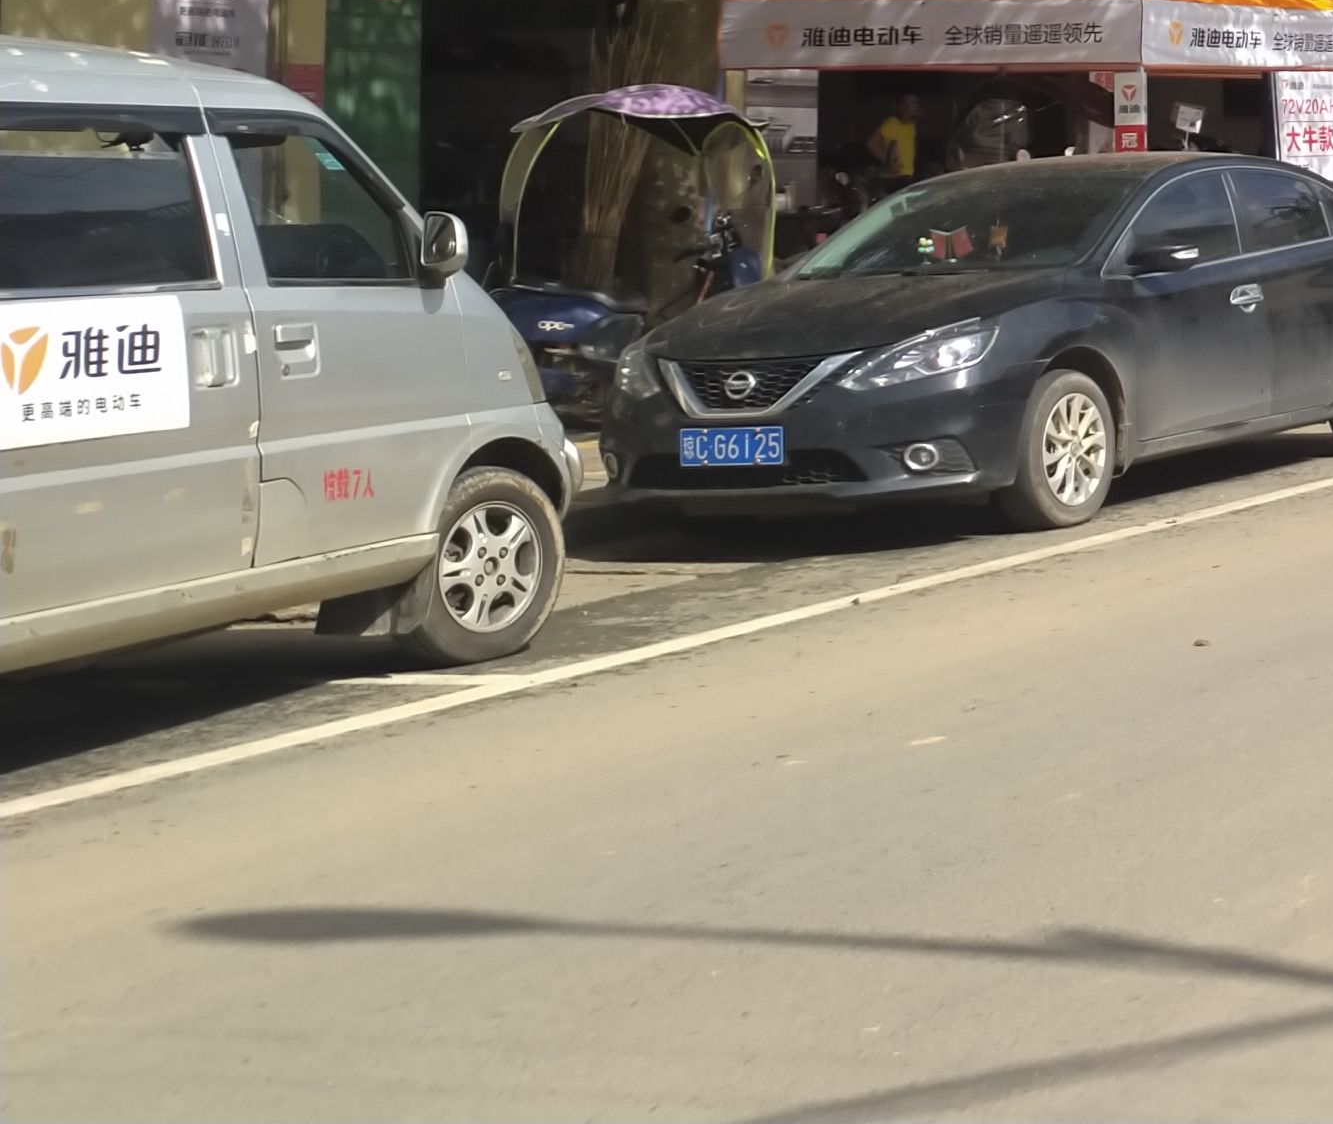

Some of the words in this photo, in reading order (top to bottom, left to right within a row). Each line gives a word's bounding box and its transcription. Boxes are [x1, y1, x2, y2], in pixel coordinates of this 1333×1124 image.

[801, 26, 923, 47] 雅迪电动车
[944, 23, 1103, 46] 全球销量遥遥领先
[1189, 27, 1263, 49] 雅迪电动车
[59, 323, 162, 380] 雅迪
[21, 393, 143, 423] 更高端的电动车
